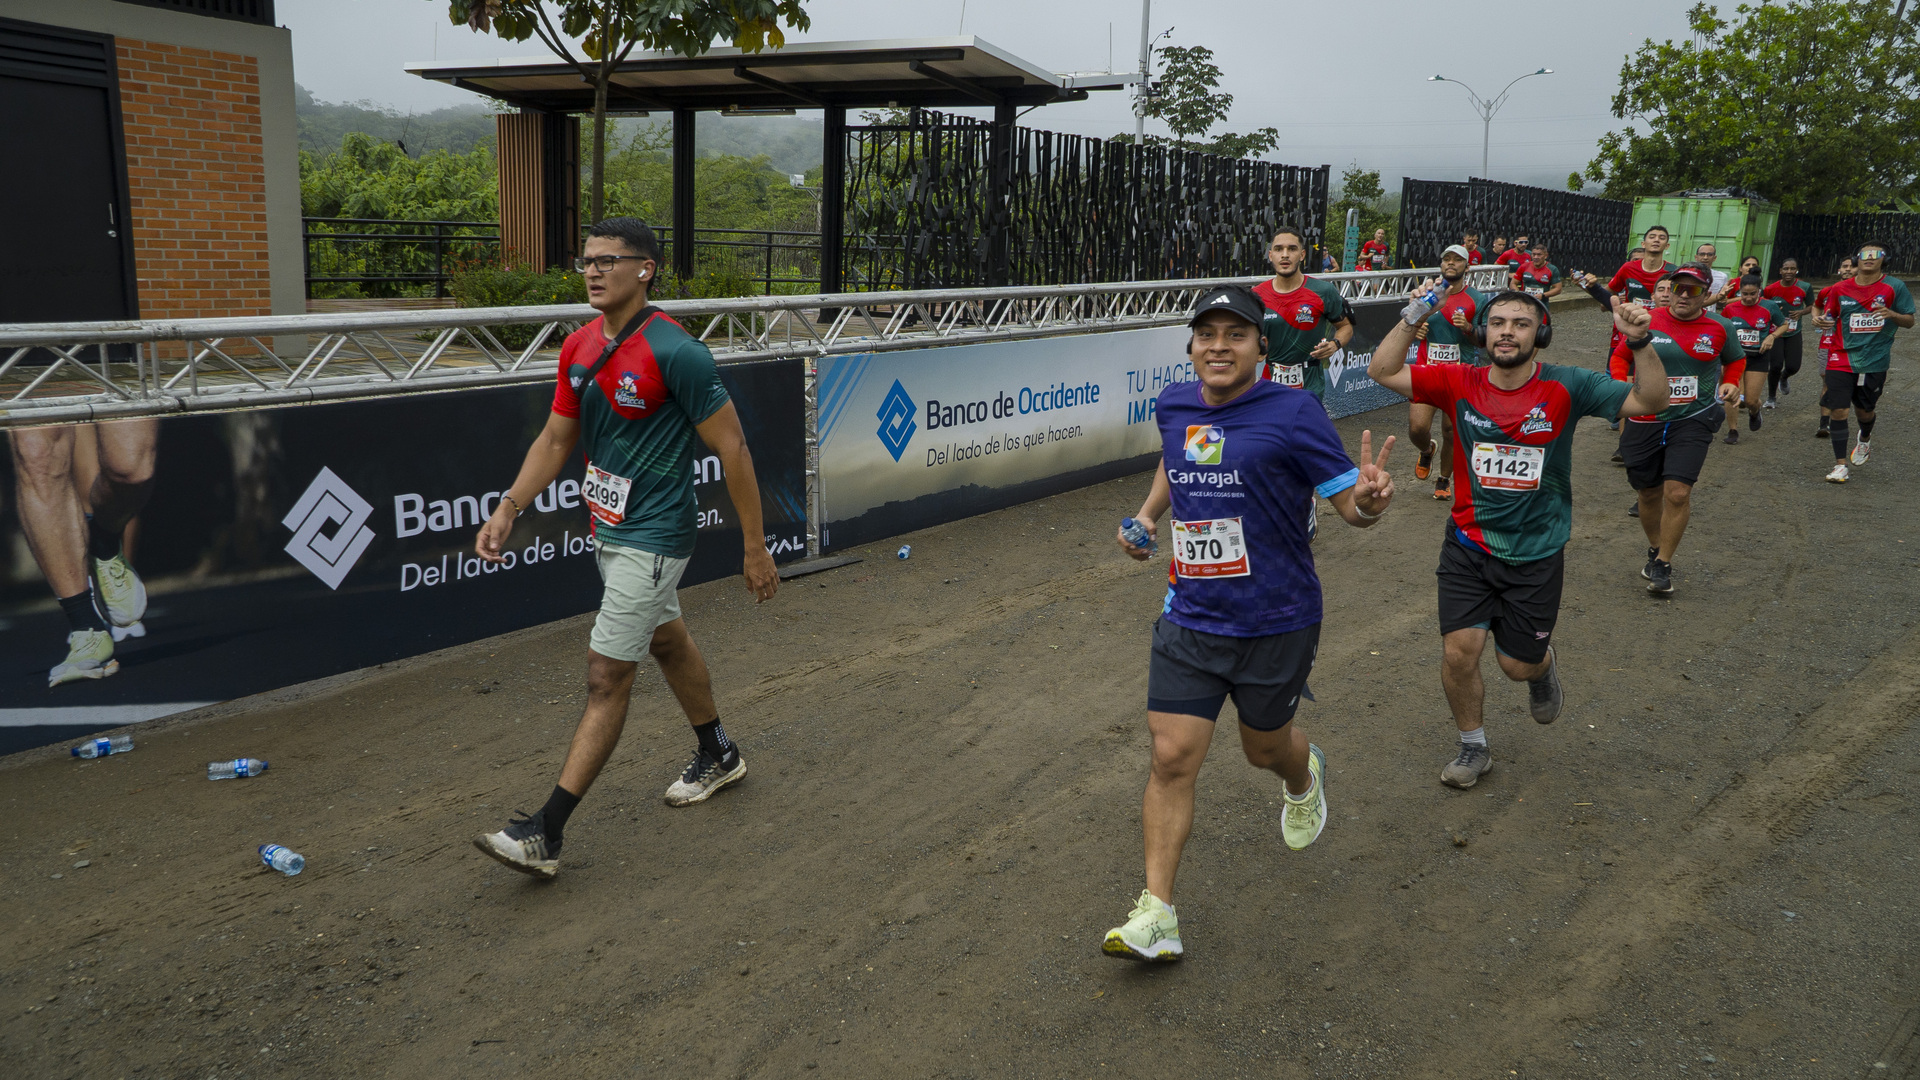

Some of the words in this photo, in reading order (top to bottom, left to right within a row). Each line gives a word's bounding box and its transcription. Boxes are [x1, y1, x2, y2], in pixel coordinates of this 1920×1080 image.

[1346, 350, 1372, 370] Banco
[1433, 350, 1455, 360] 1021
[1126, 369, 1147, 394] TU
[1273, 372, 1298, 384] 1113
[1344, 379, 1355, 393] Del
[926, 400, 988, 430] Banco
[992, 391, 1014, 419] de
[1018, 381, 1100, 415] Occidente
[926, 444, 950, 467] Del
[952, 440, 982, 463] lado
[984, 436, 1000, 455] de
[1003, 433, 1020, 451] los
[1023, 432, 1045, 452] que
[1047, 425, 1083, 443] hacen.
[1482, 458, 1530, 477] 1142
[1168, 469, 1243, 488] Carvajal
[394, 488, 524, 539] Banc
[1186, 538, 1223, 560] 970
[401, 555, 448, 592] Del
[523, 536, 556, 565] de
[563, 530, 595, 557] los
